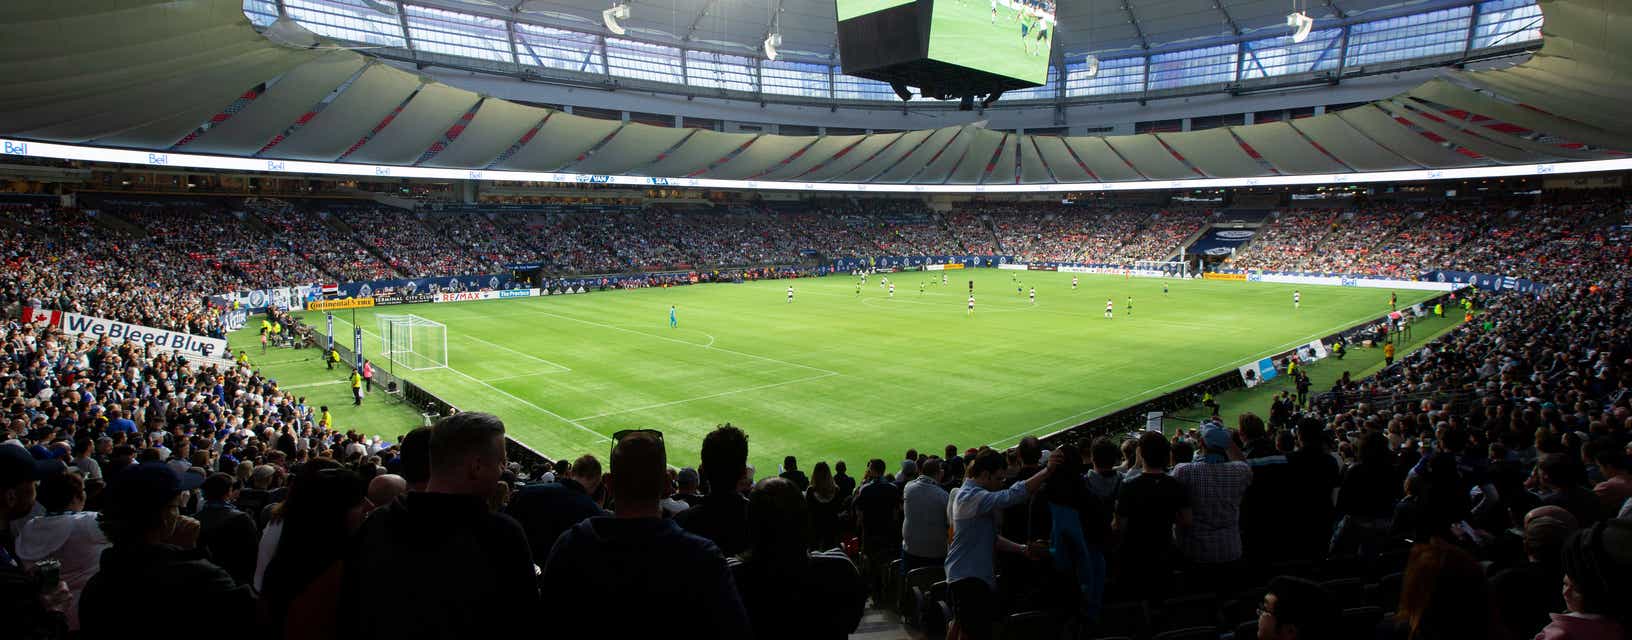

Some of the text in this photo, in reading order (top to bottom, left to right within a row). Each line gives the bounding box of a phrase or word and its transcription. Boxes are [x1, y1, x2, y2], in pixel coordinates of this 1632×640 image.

[4, 141, 28, 155] Bell
[149, 153, 168, 165] Bell
[268, 160, 285, 171] Bell
[375, 166, 390, 176] Bell
[443, 292, 480, 301] RE/MAX
[310, 300, 351, 310] Continental
[68, 316, 215, 354] We Bleed Blue
